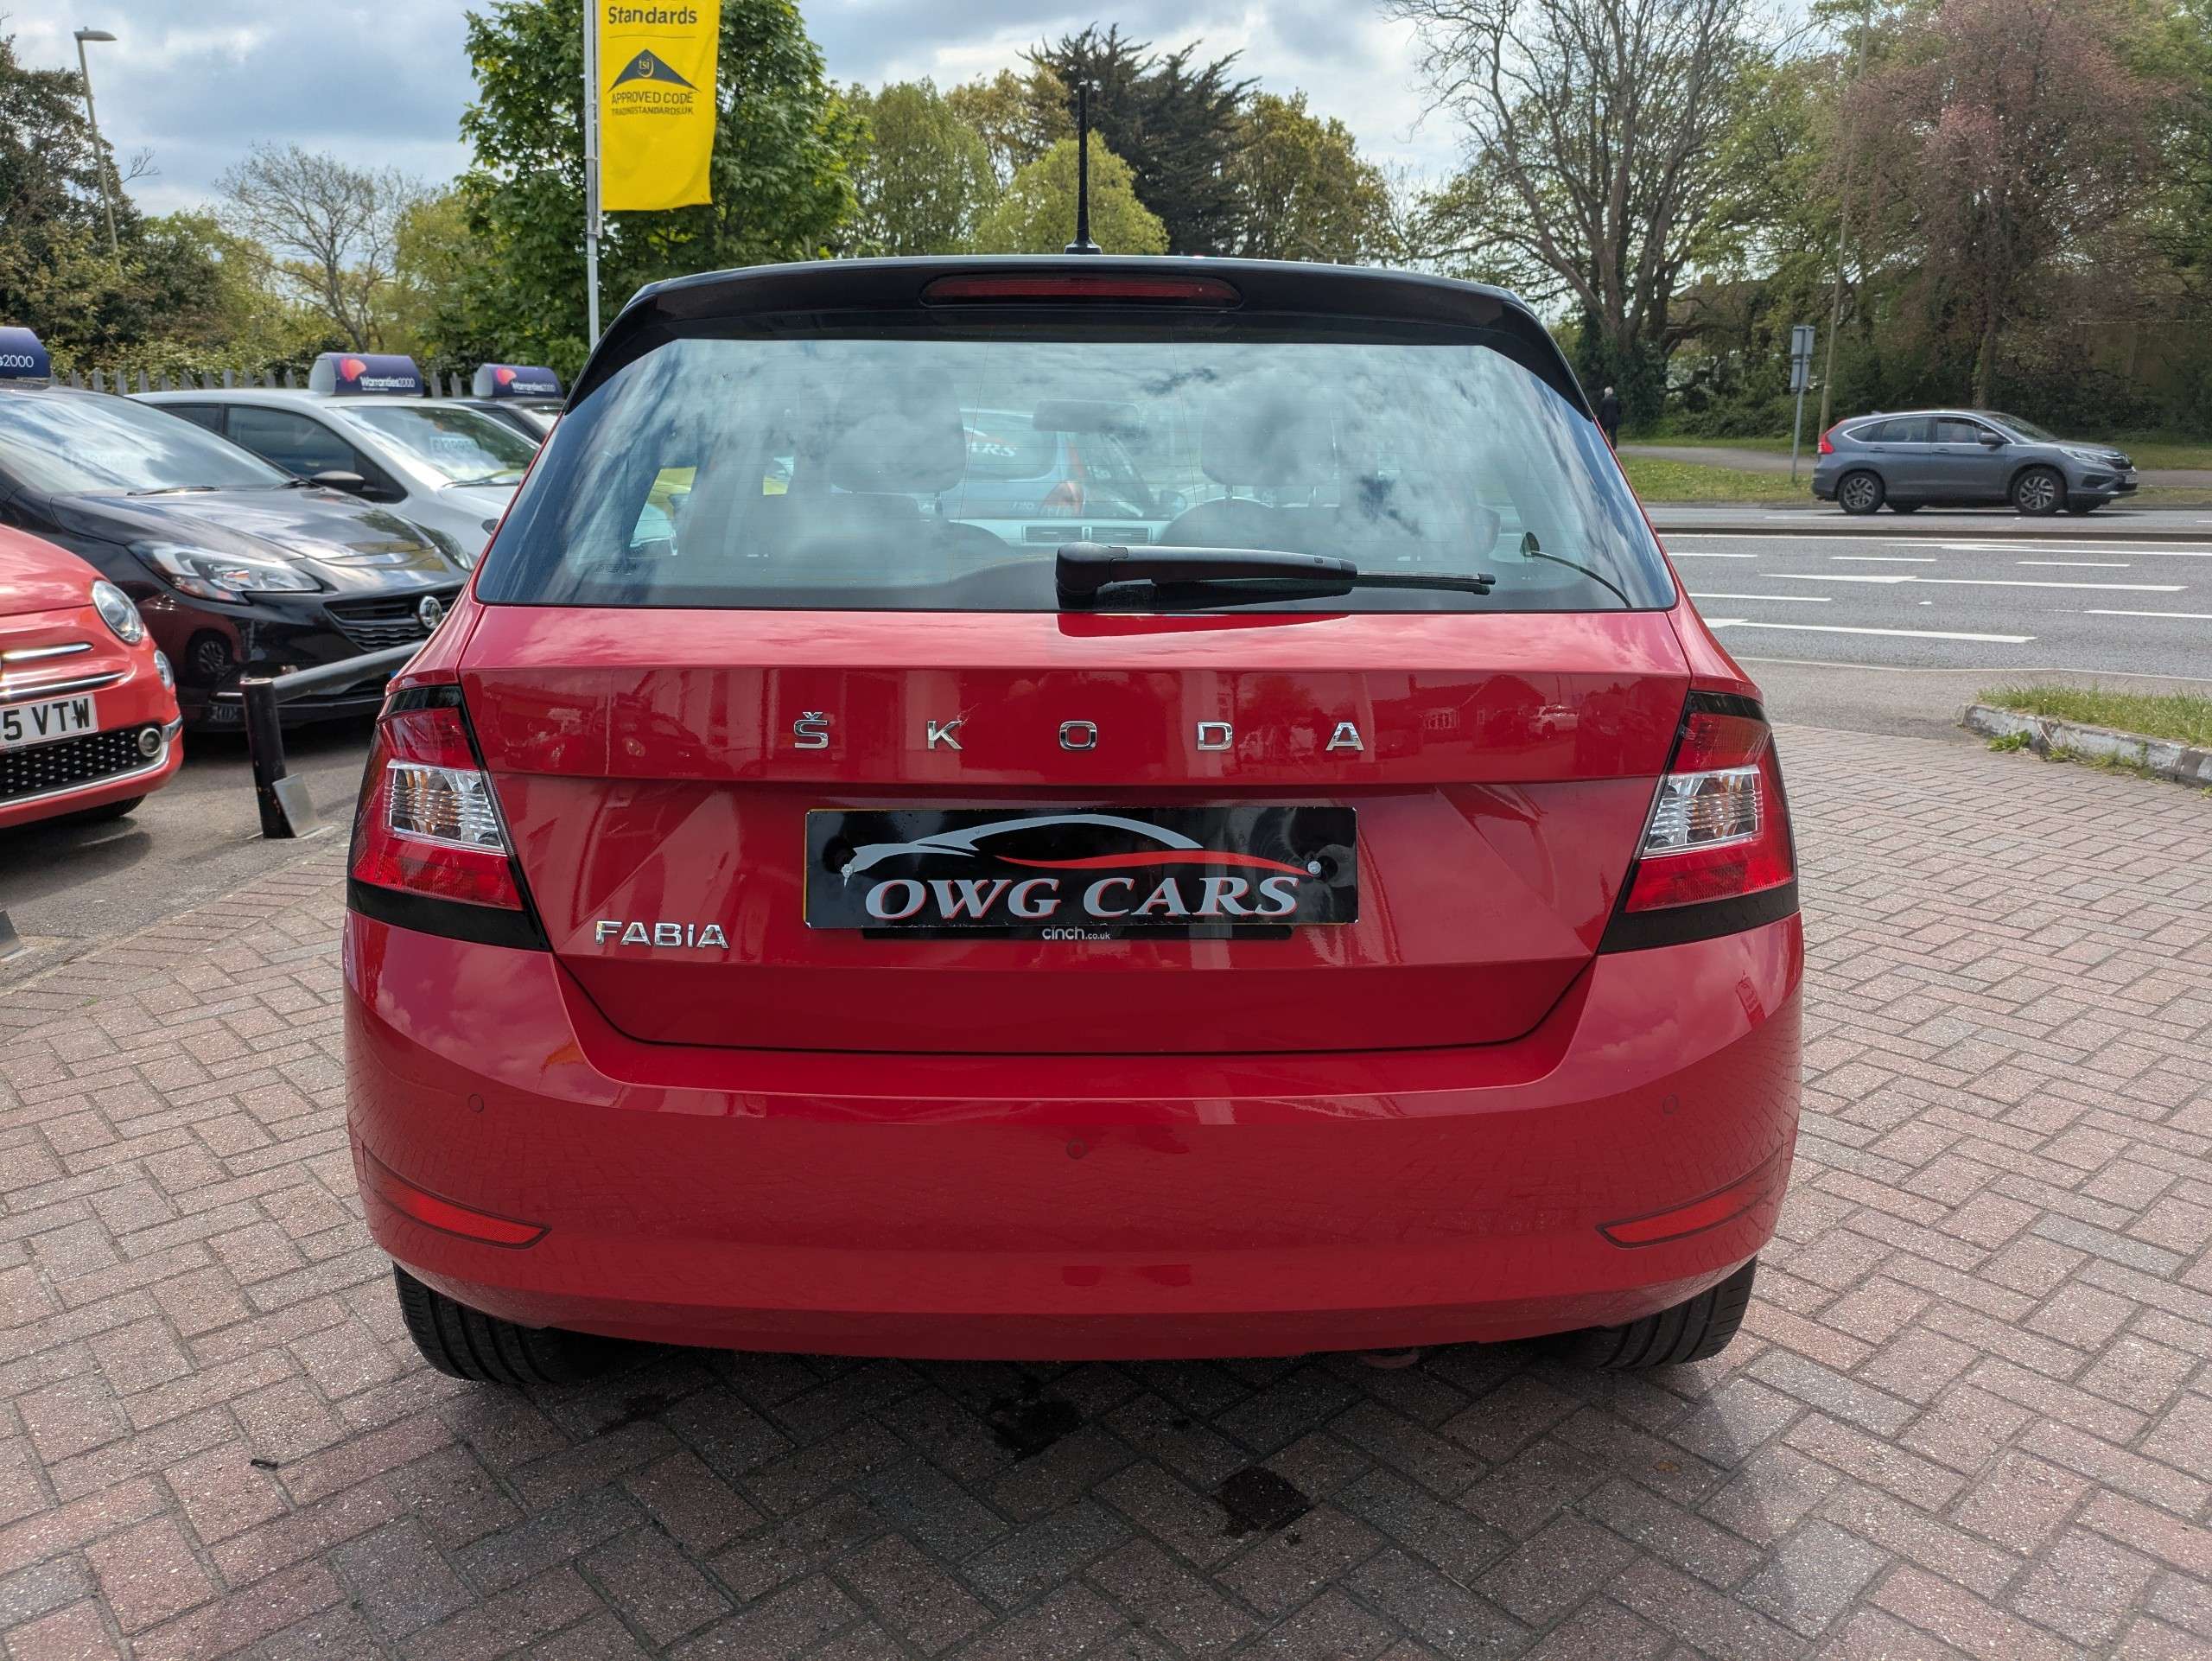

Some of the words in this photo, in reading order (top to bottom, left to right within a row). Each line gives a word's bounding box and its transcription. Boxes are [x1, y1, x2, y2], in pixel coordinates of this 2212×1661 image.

[608, 6, 697, 24] Standards
[612, 91, 661, 105] APPROVED
[664, 92, 694, 105] CODE
[31, 697, 90, 735] VTW
[865, 878, 1061, 920] OWG
[1083, 876, 1300, 918] CARS
[1041, 926, 1111, 940] cinch.co.uk
